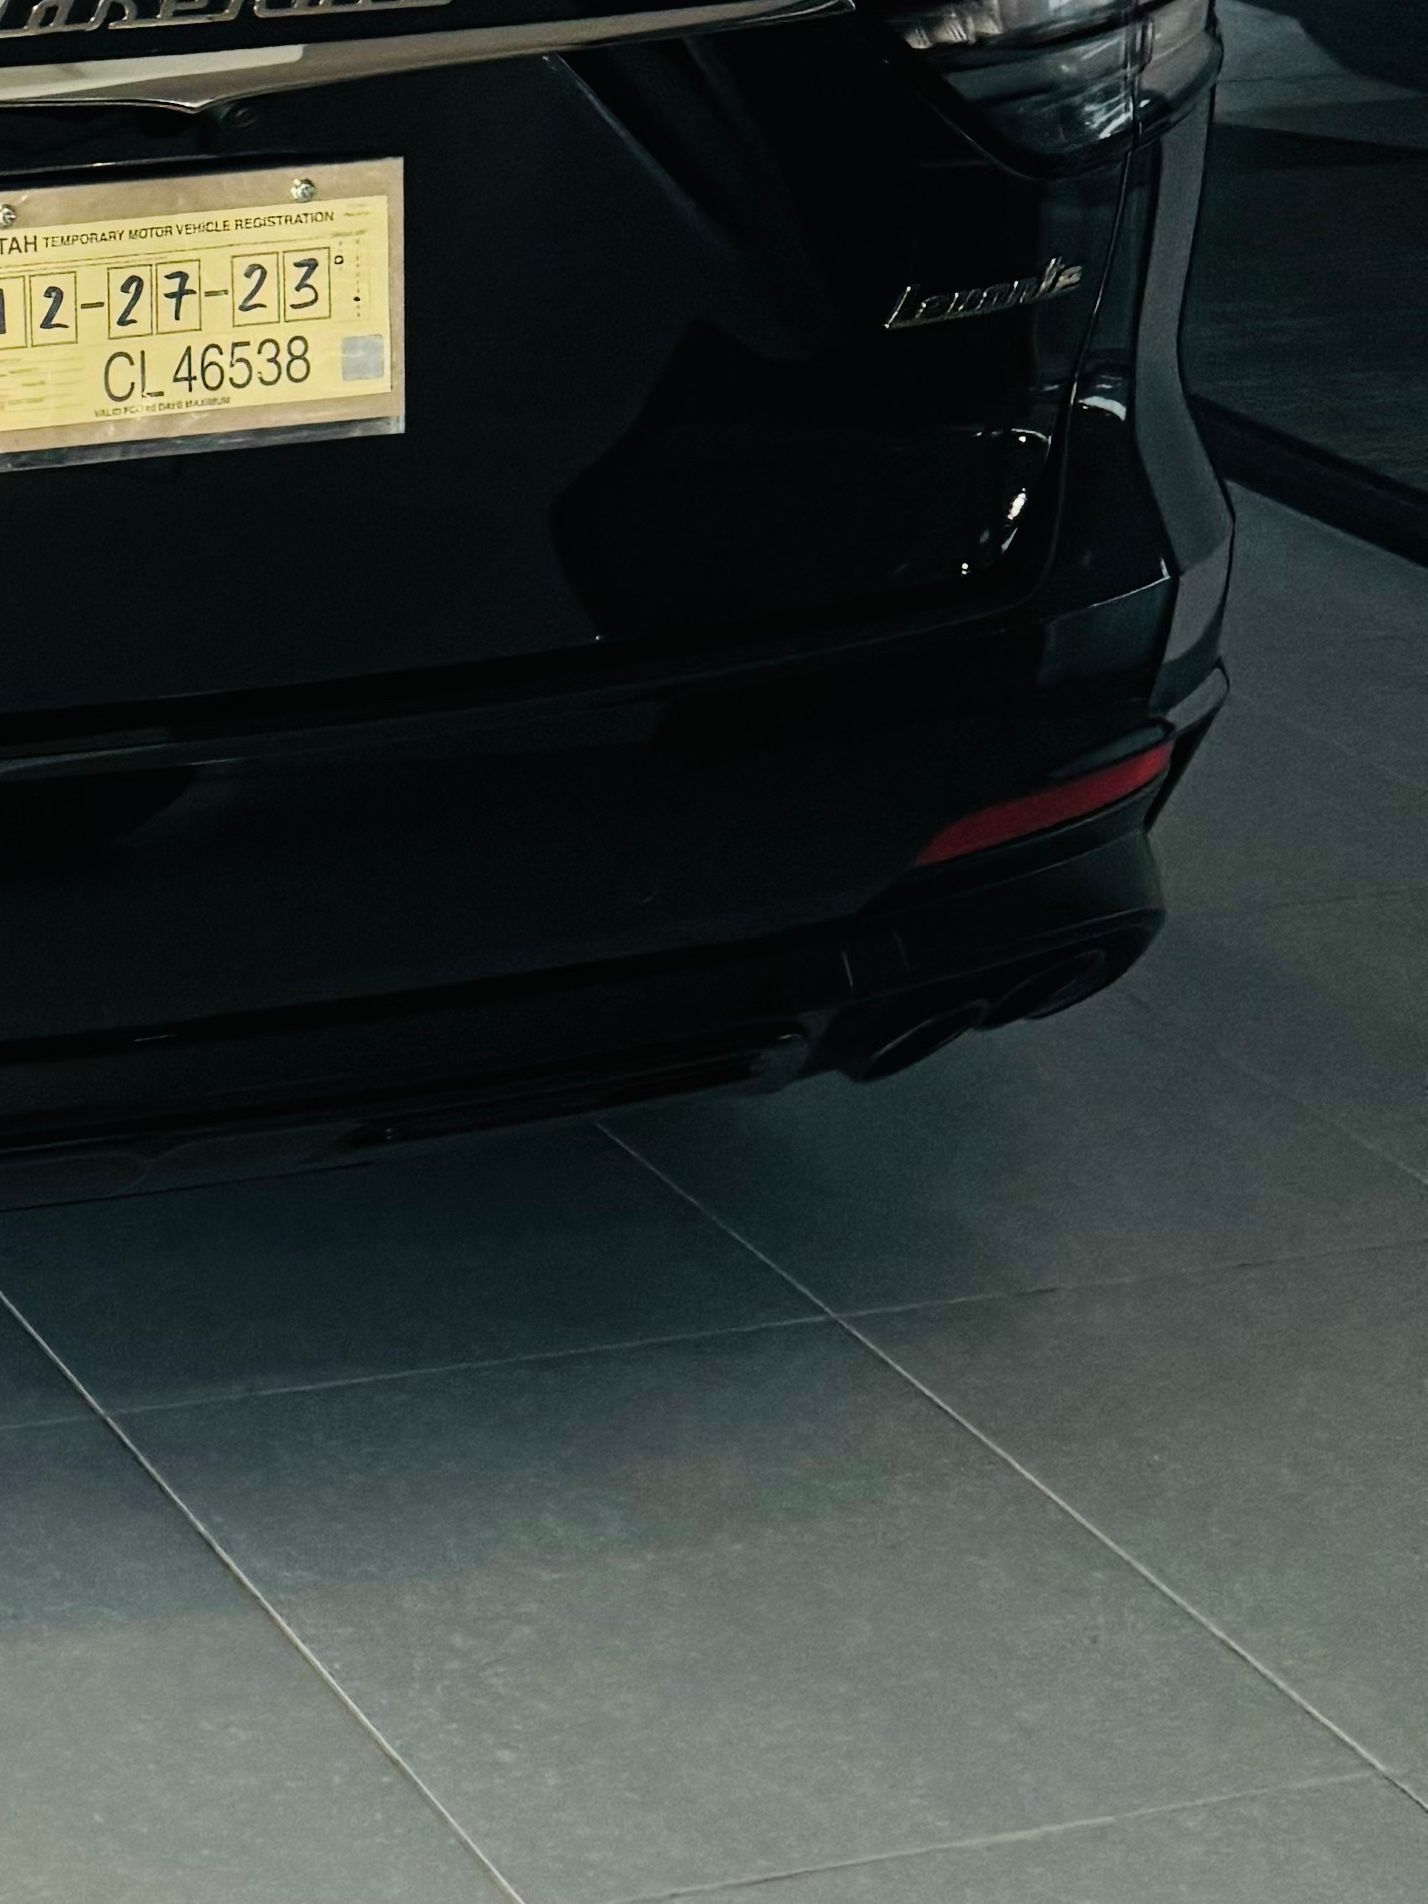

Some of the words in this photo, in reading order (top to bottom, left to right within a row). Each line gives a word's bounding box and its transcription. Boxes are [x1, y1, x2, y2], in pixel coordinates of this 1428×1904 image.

[43, 229, 125, 248] TEMPORARY
[128, 225, 173, 240] MOTOR
[177, 219, 230, 235] VEHICLE
[234, 210, 334, 230] REGISTRATION
[104, 349, 165, 403] CL
[172, 335, 311, 393] 46538
